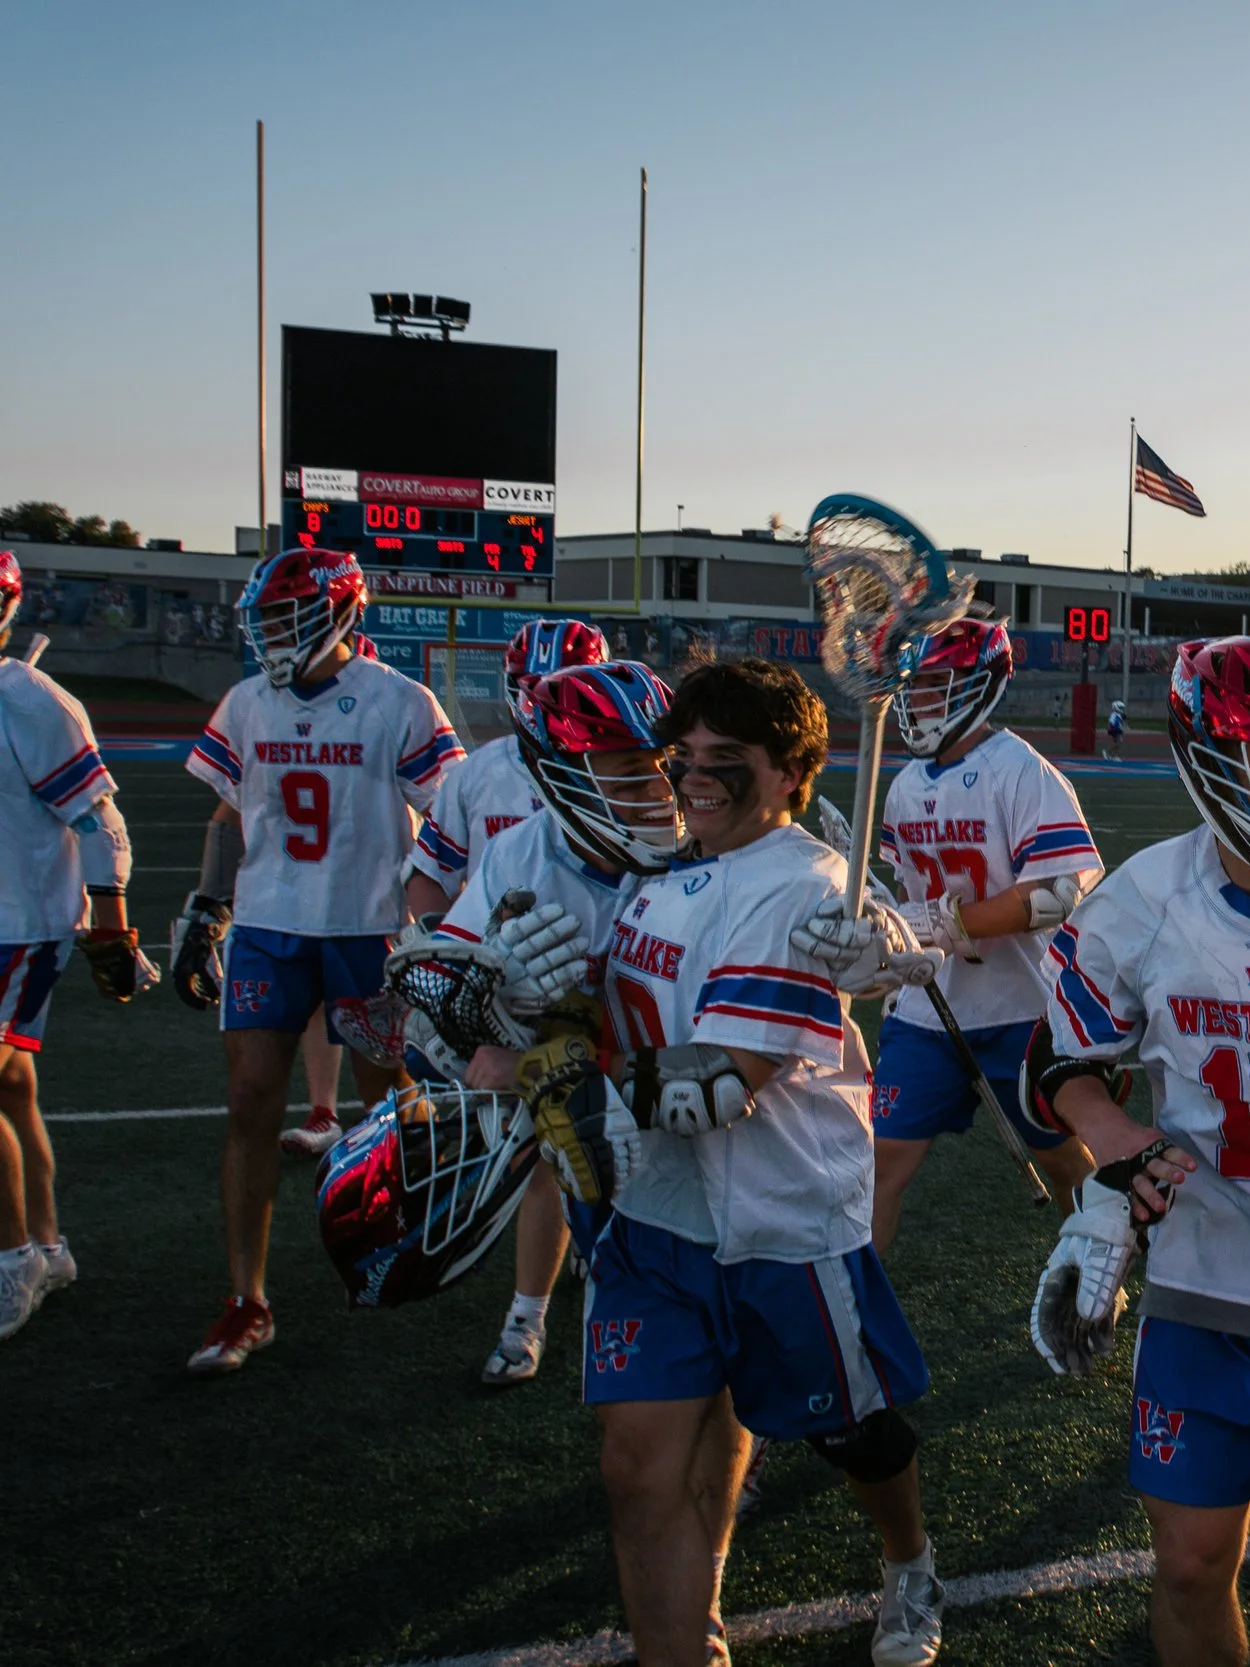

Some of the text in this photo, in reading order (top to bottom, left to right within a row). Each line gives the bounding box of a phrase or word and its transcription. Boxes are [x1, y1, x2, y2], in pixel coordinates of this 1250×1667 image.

[363, 477, 420, 495] COVERT
[421, 484, 445, 496] AUTO
[447, 486, 479, 499] GROUP
[485, 486, 555, 503] COVERT
[307, 512, 320, 533] 8
[531, 527, 543, 544] 4
[487, 555, 499, 572] 4
[385, 576, 458, 594] NEPTUNE
[461, 580, 505, 596] FIELD
[378, 605, 468, 627] HAT CREK
[1068, 608, 1109, 641] 80
[295, 722, 312, 737] W
[254, 742, 364, 765] WESTLAKE
[280, 770, 330, 862] 9
[898, 819, 987, 845] WESTLAKE
[613, 921, 686, 983] TLAKE
[591, 1319, 642, 1373] W
[1136, 1397, 1185, 1465] W
